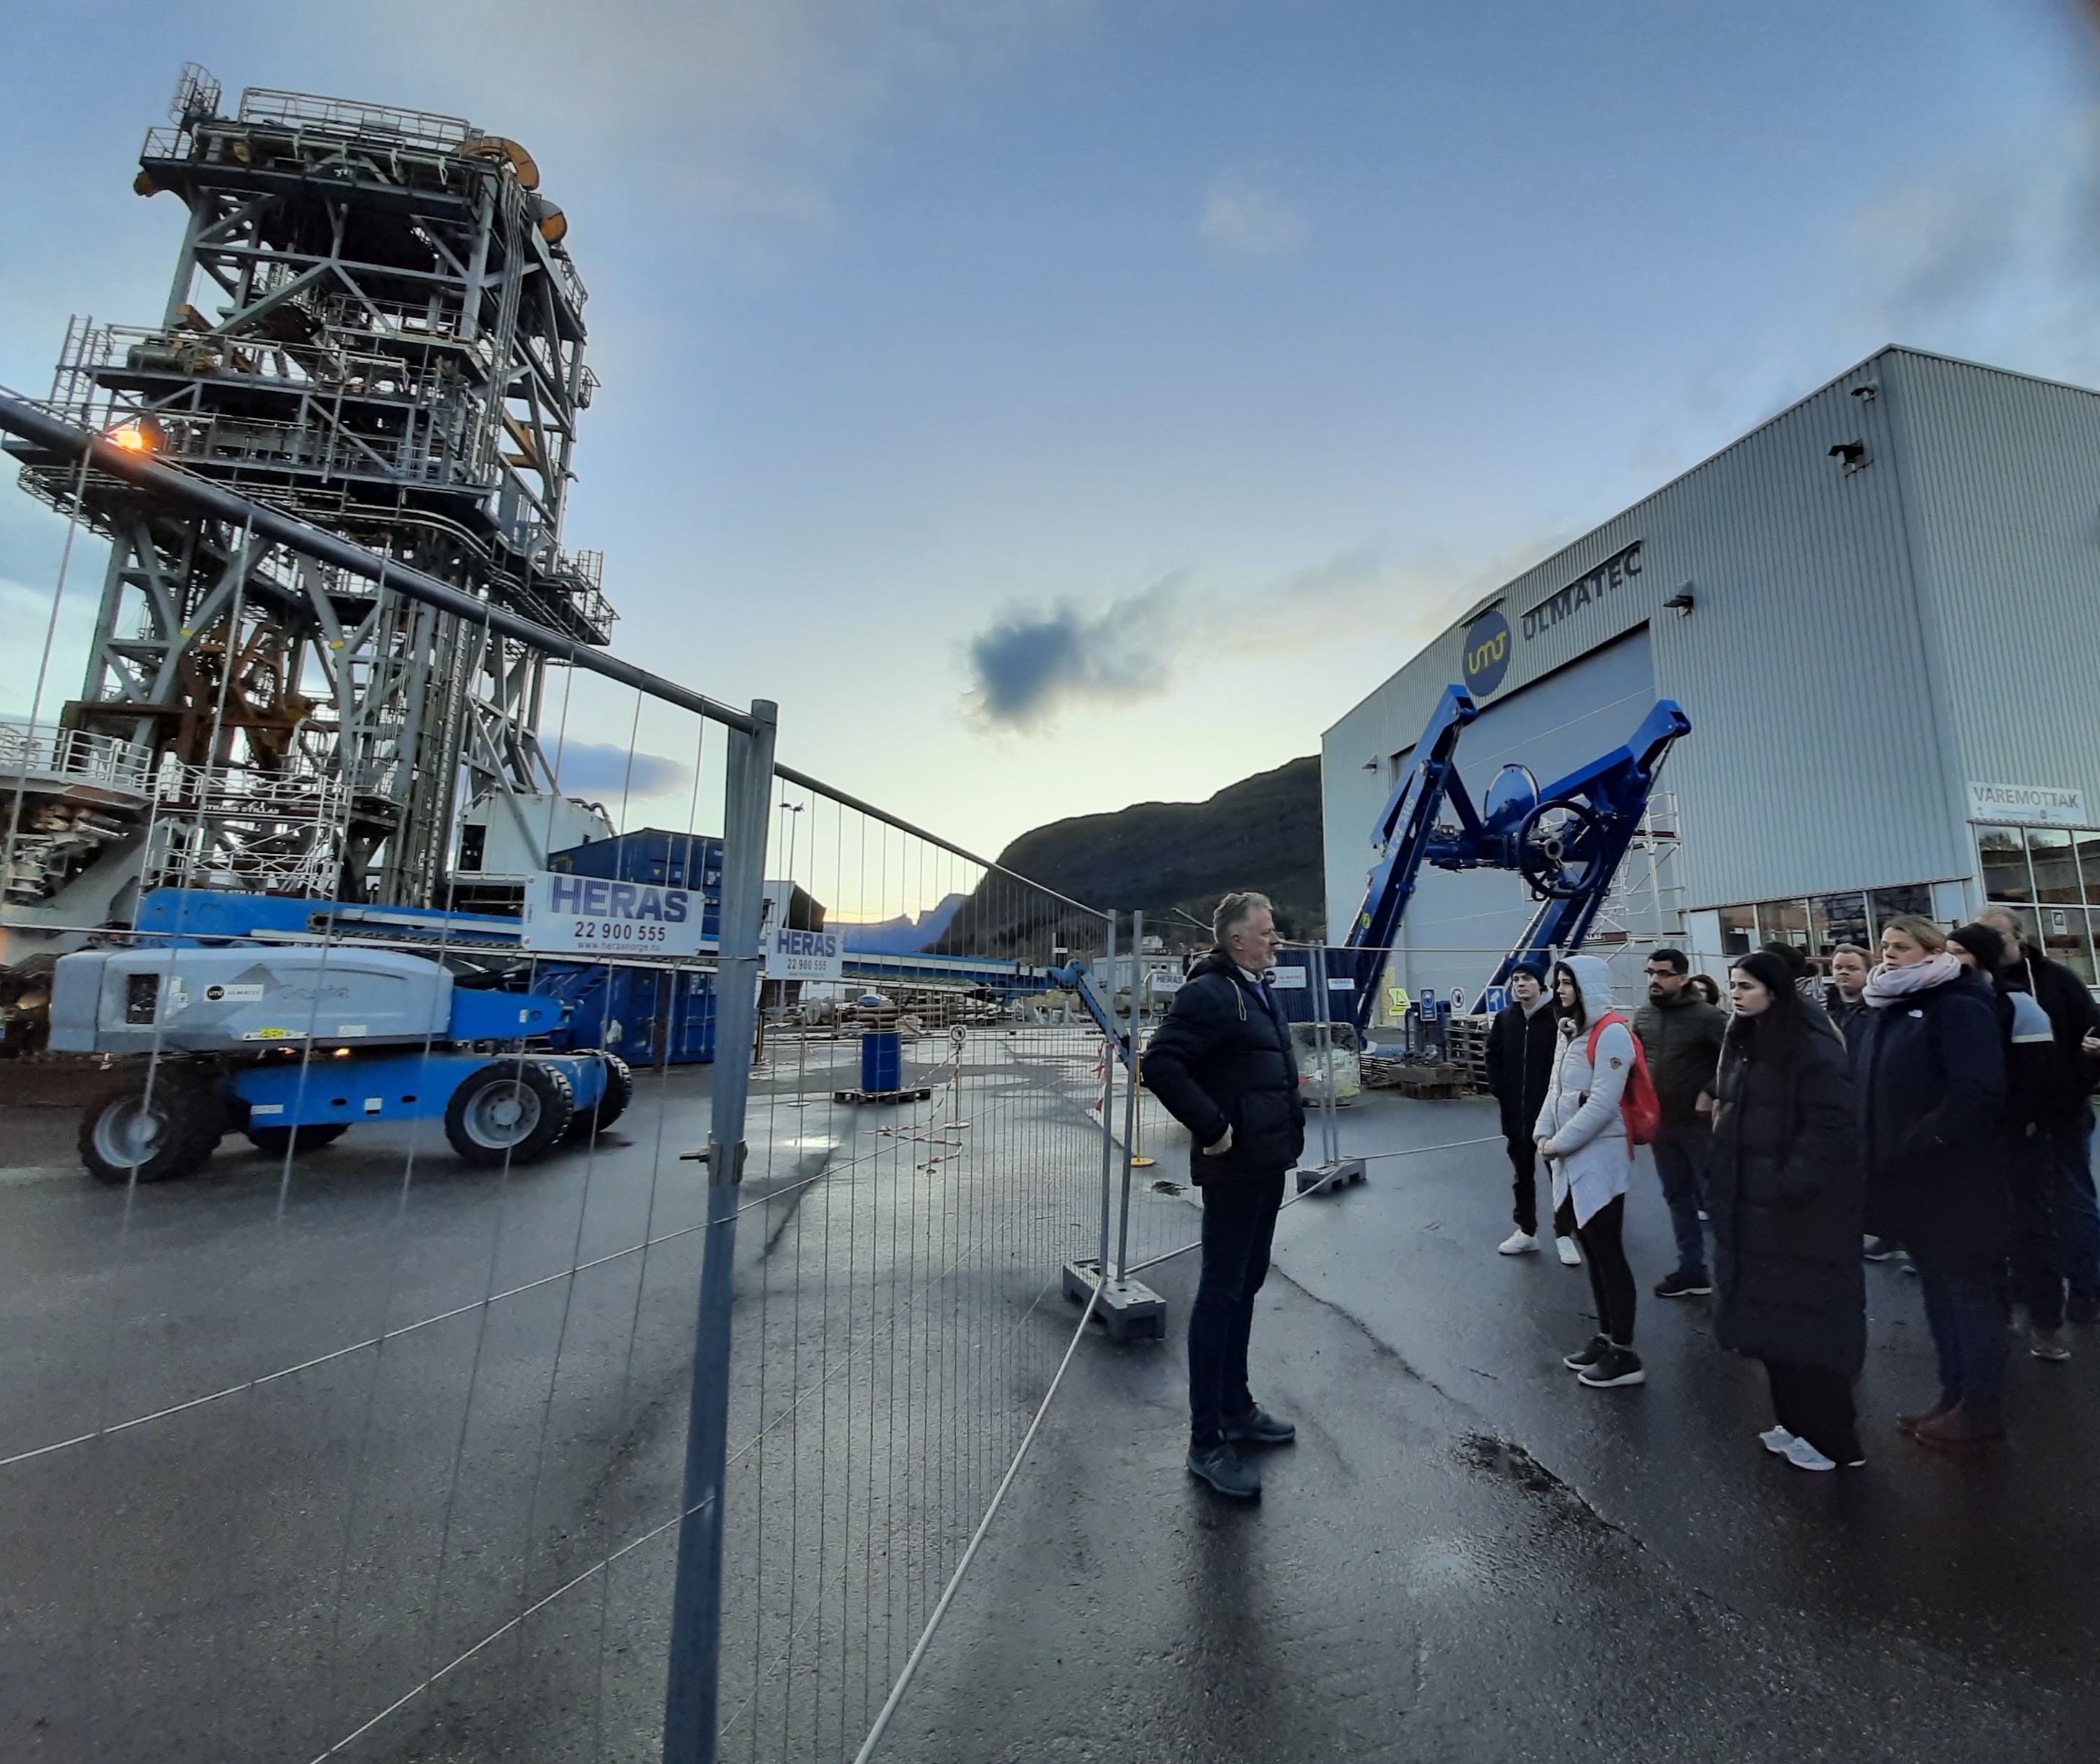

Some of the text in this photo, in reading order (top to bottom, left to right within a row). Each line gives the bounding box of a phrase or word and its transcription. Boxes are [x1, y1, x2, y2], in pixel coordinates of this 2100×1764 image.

[1522, 546, 1643, 641] ULMATEC
[1973, 786, 2079, 809] VAREMOTTAK
[1402, 796, 1415, 825] SWL
[551, 876, 689, 923] HERAS
[574, 921, 666, 942] 22 900 555
[577, 940, 661, 953] www.herasnorge.no
[777, 929, 836, 958] HERAS
[787, 958, 827, 971] 22 900 555
[1156, 975, 1184, 984] HERAS
